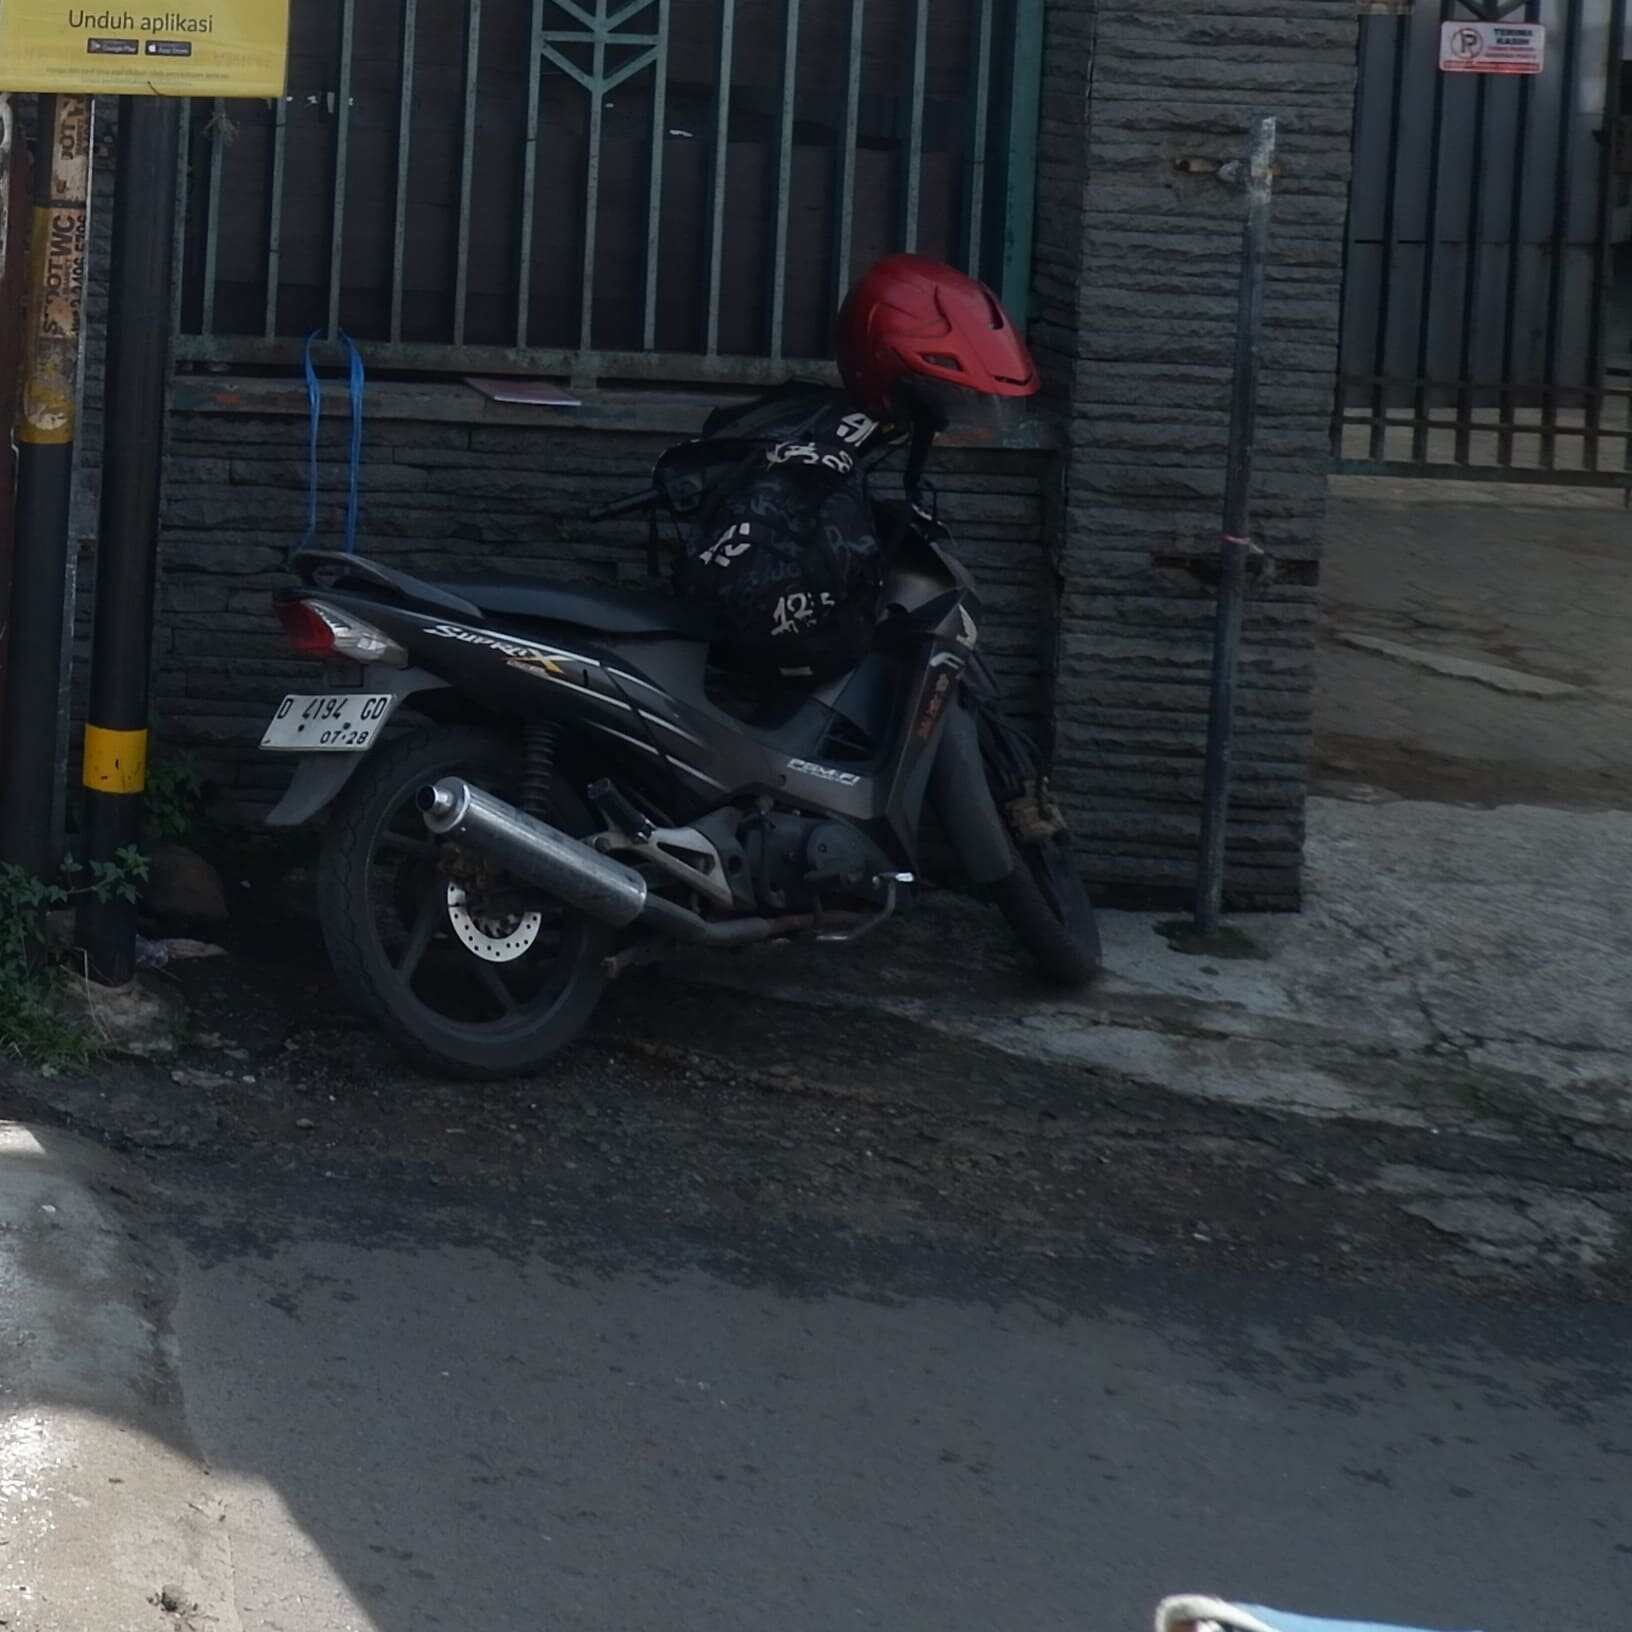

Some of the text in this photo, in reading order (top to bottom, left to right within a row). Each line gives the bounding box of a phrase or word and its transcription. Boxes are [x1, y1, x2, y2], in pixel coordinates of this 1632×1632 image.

[68, 9, 213, 34] Unduh aplikasi
[277, 697, 388, 720] D 4194 GD
